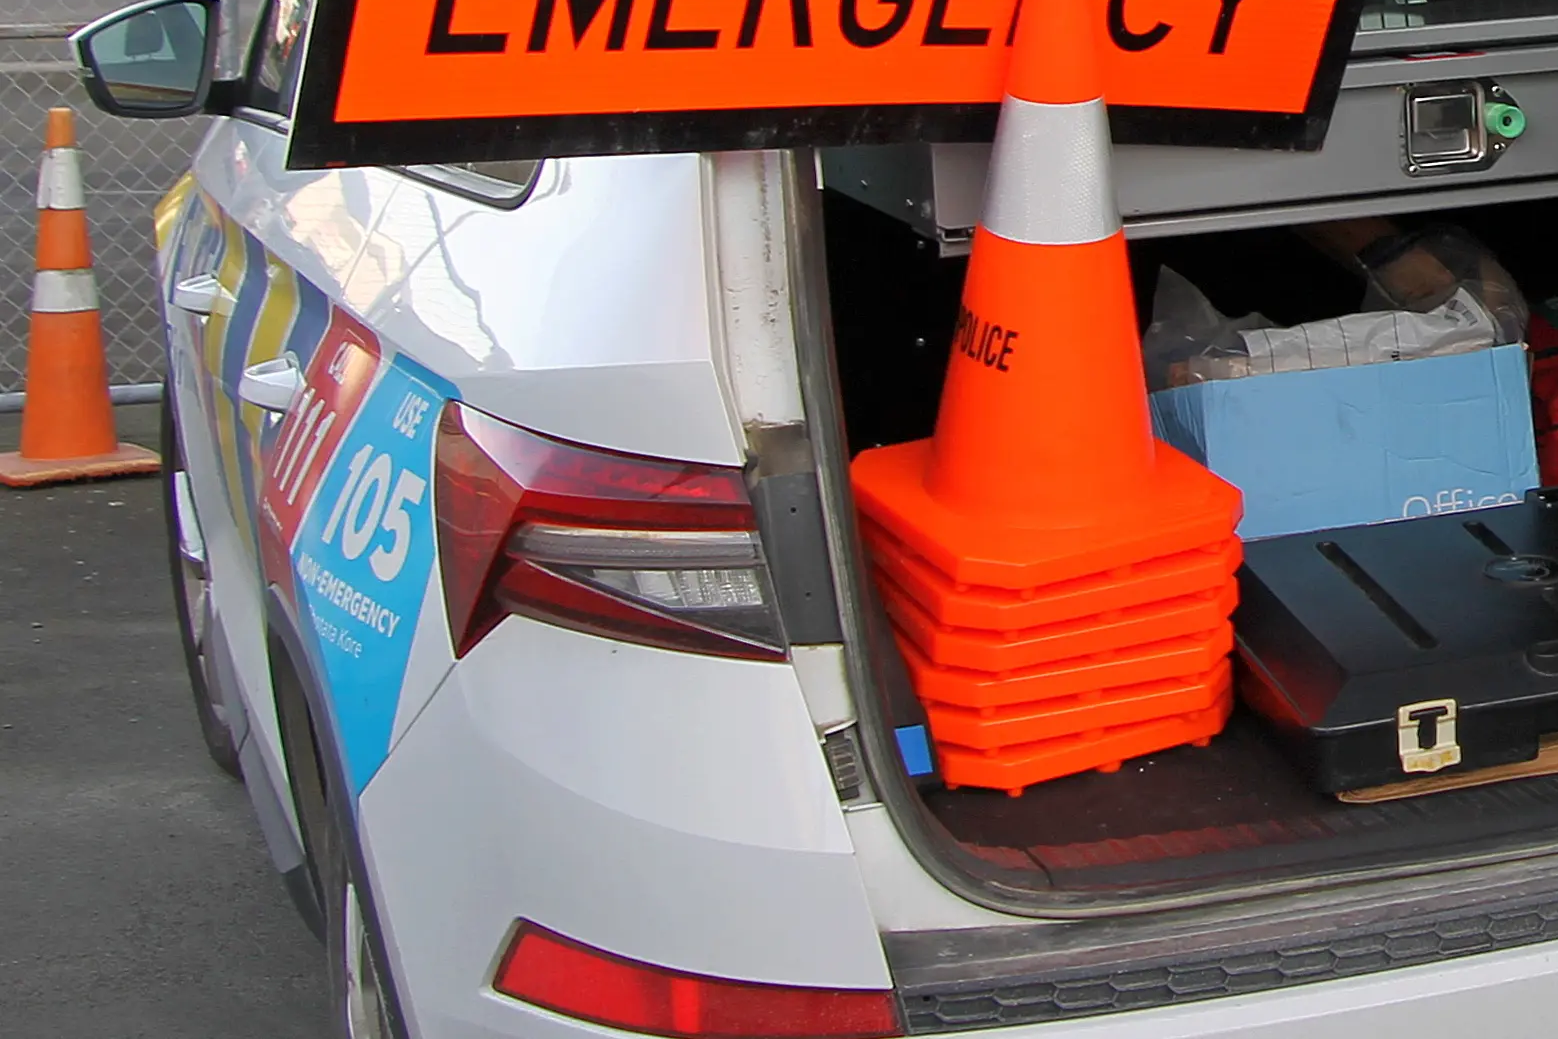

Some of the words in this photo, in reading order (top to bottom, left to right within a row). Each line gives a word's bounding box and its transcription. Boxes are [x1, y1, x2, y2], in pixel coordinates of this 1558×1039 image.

[273, 388, 336, 505] 111
[392, 392, 429, 439] USE
[322, 444, 427, 581] 105
